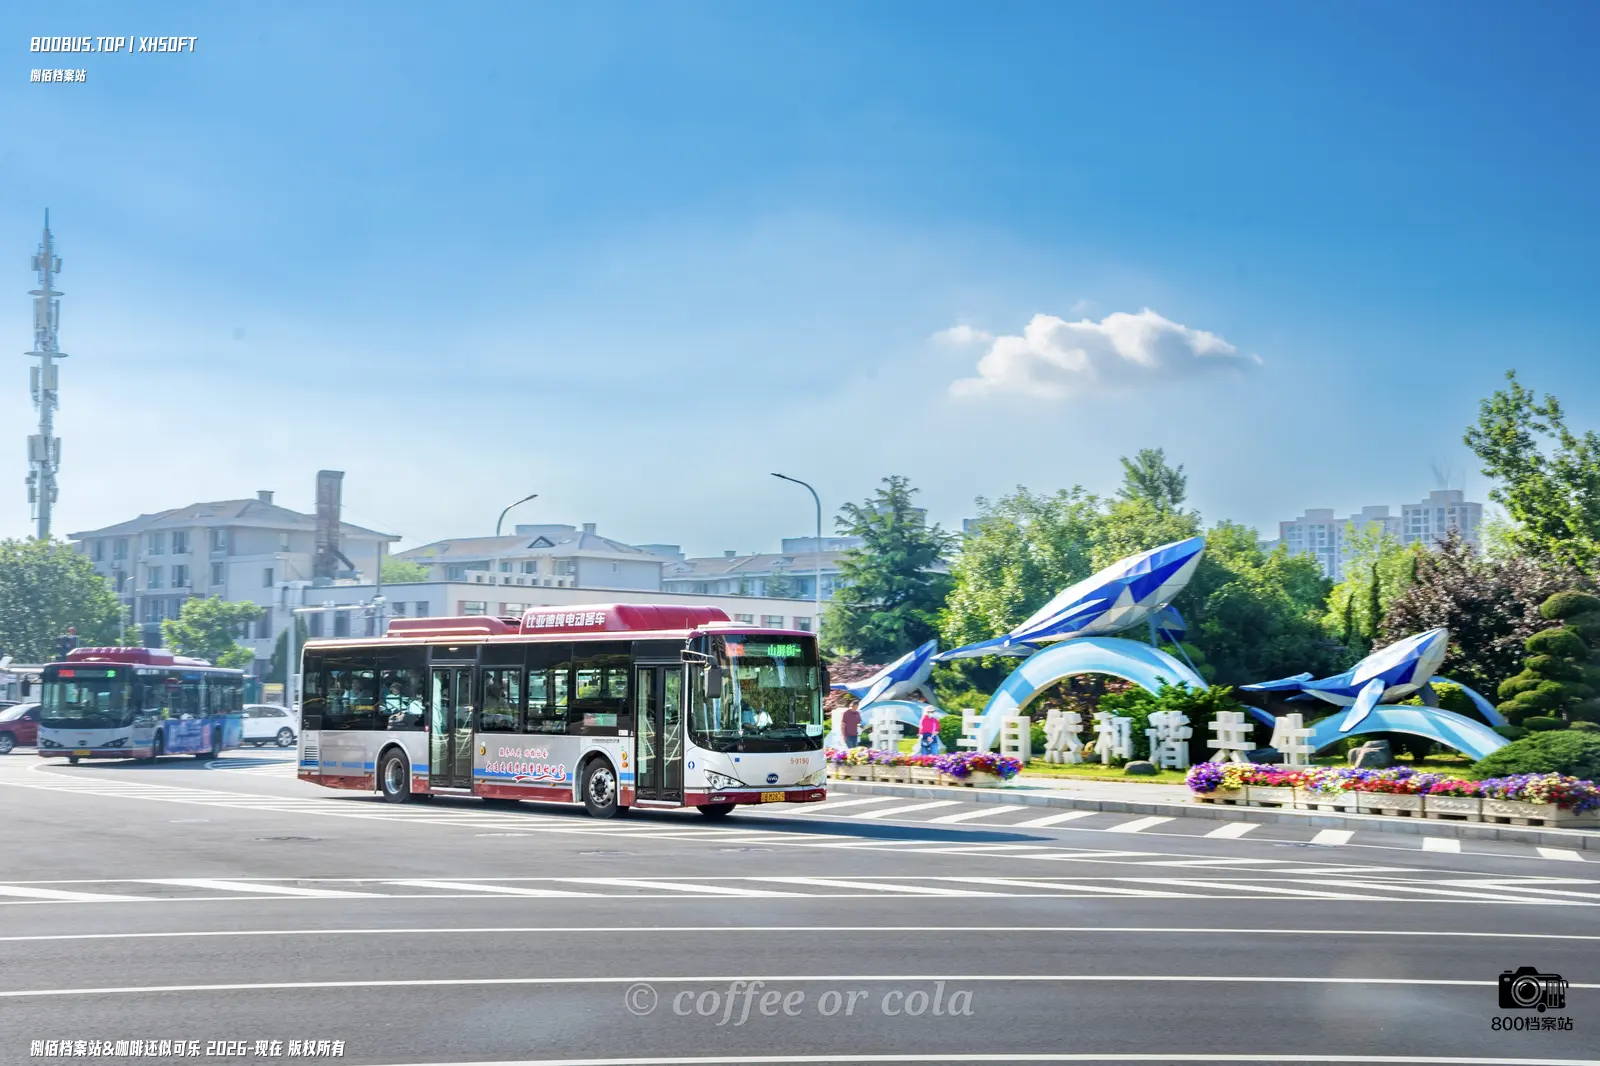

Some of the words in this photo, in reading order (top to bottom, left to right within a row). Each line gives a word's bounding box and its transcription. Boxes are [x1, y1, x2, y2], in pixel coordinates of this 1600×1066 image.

[526, 611, 606, 629] 比亚迪纯电动客车
